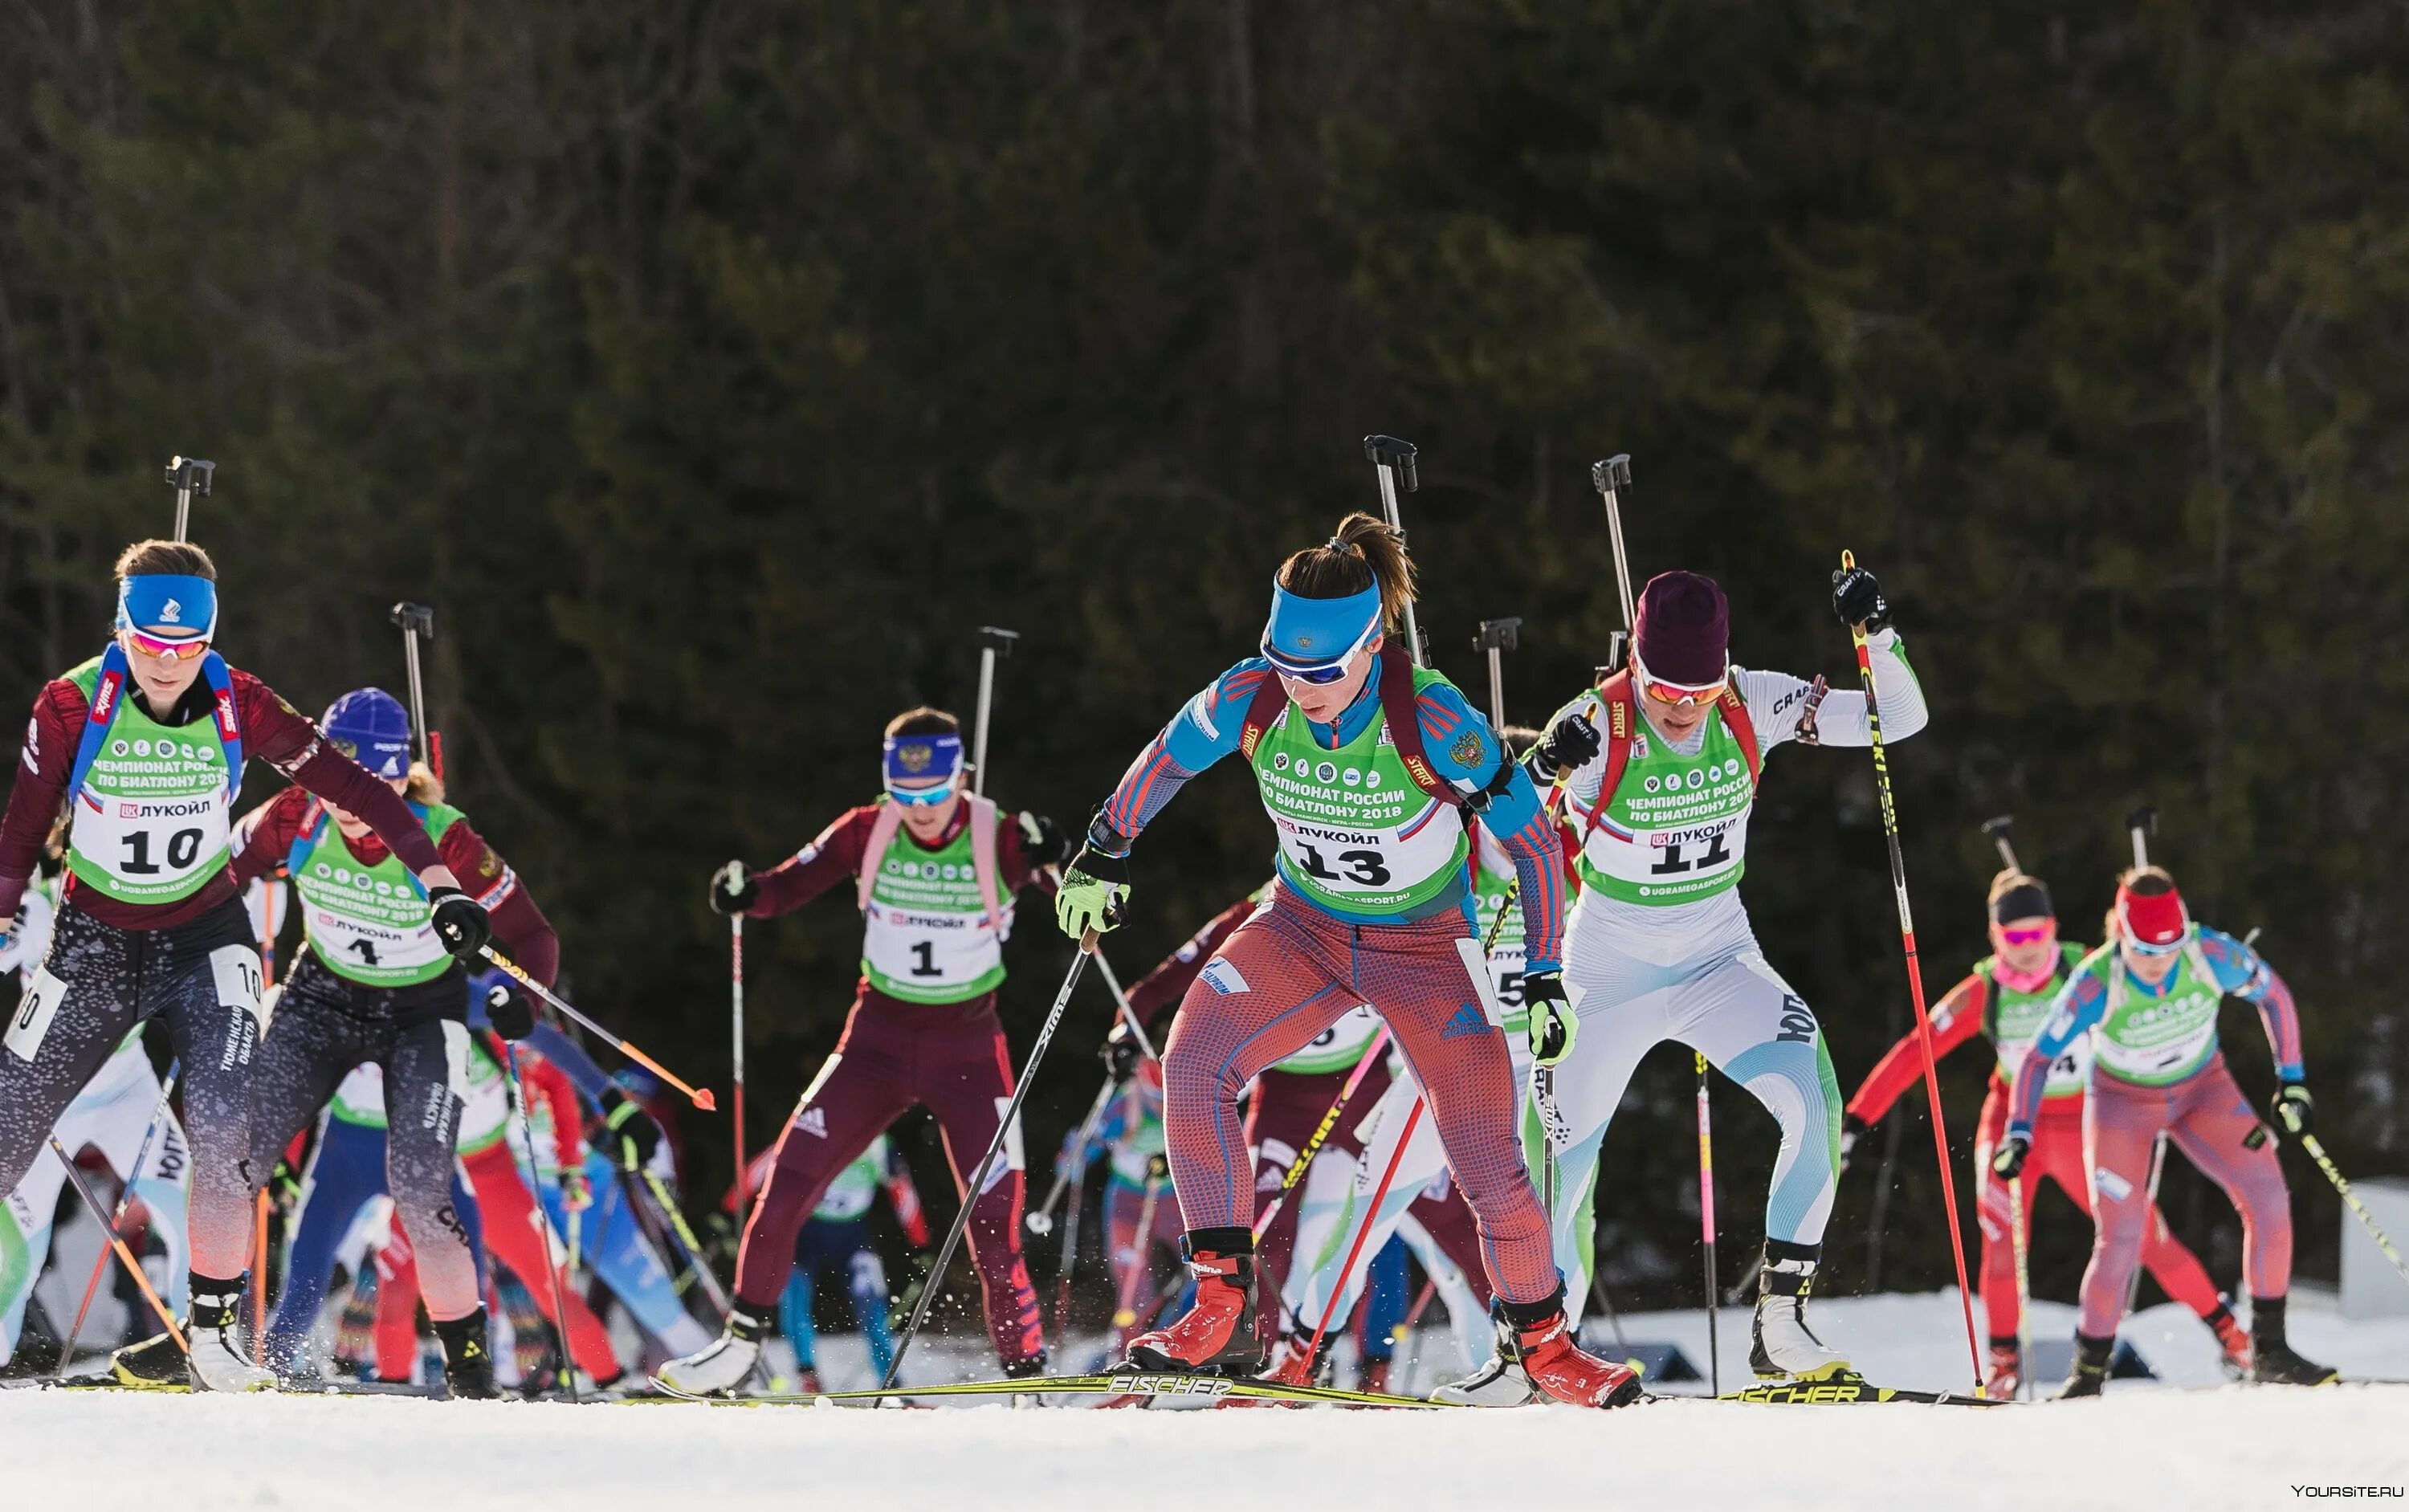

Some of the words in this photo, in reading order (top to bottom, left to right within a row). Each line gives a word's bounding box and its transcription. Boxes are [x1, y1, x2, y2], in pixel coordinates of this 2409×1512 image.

[92, 759, 181, 773] ЧЕМПИОНАТ
[98, 773, 117, 787] ПО
[120, 774, 197, 788] БИАТЛОНУ
[140, 801, 210, 817] ЛУКОЙЛ
[1275, 792, 1357, 817] БИАТЛОНУ
[1362, 805, 1402, 819] 2018
[1343, 789, 1405, 805] РОССИИ
[1626, 789, 1710, 810] ЧЕМПИОНАТ
[1630, 812, 1650, 823] ПО
[1653, 799, 1726, 822] БИАТЛОНУ
[1298, 826, 1380, 845] ЛУКОЙЛ
[1670, 817, 1737, 844] ЛУКОЙЛ
[120, 828, 204, 874] 10
[1295, 838, 1391, 886] 13
[1651, 833, 1730, 874] 11
[336, 920, 402, 940] ЛУКОЙЛ
[911, 940, 943, 976] 1
[238, 963, 261, 1005] 10
[1040, 984, 1073, 1045] SWIX
[220, 1005, 243, 1072] ТЮМЕНСКАЯ
[239, 1020, 255, 1066] ОБЛАСТЬ
[1441, 1023, 1492, 1040] adidas
[1544, 1092, 1554, 1143] SWIX
[1107, 1375, 1235, 1396] FISCHER
